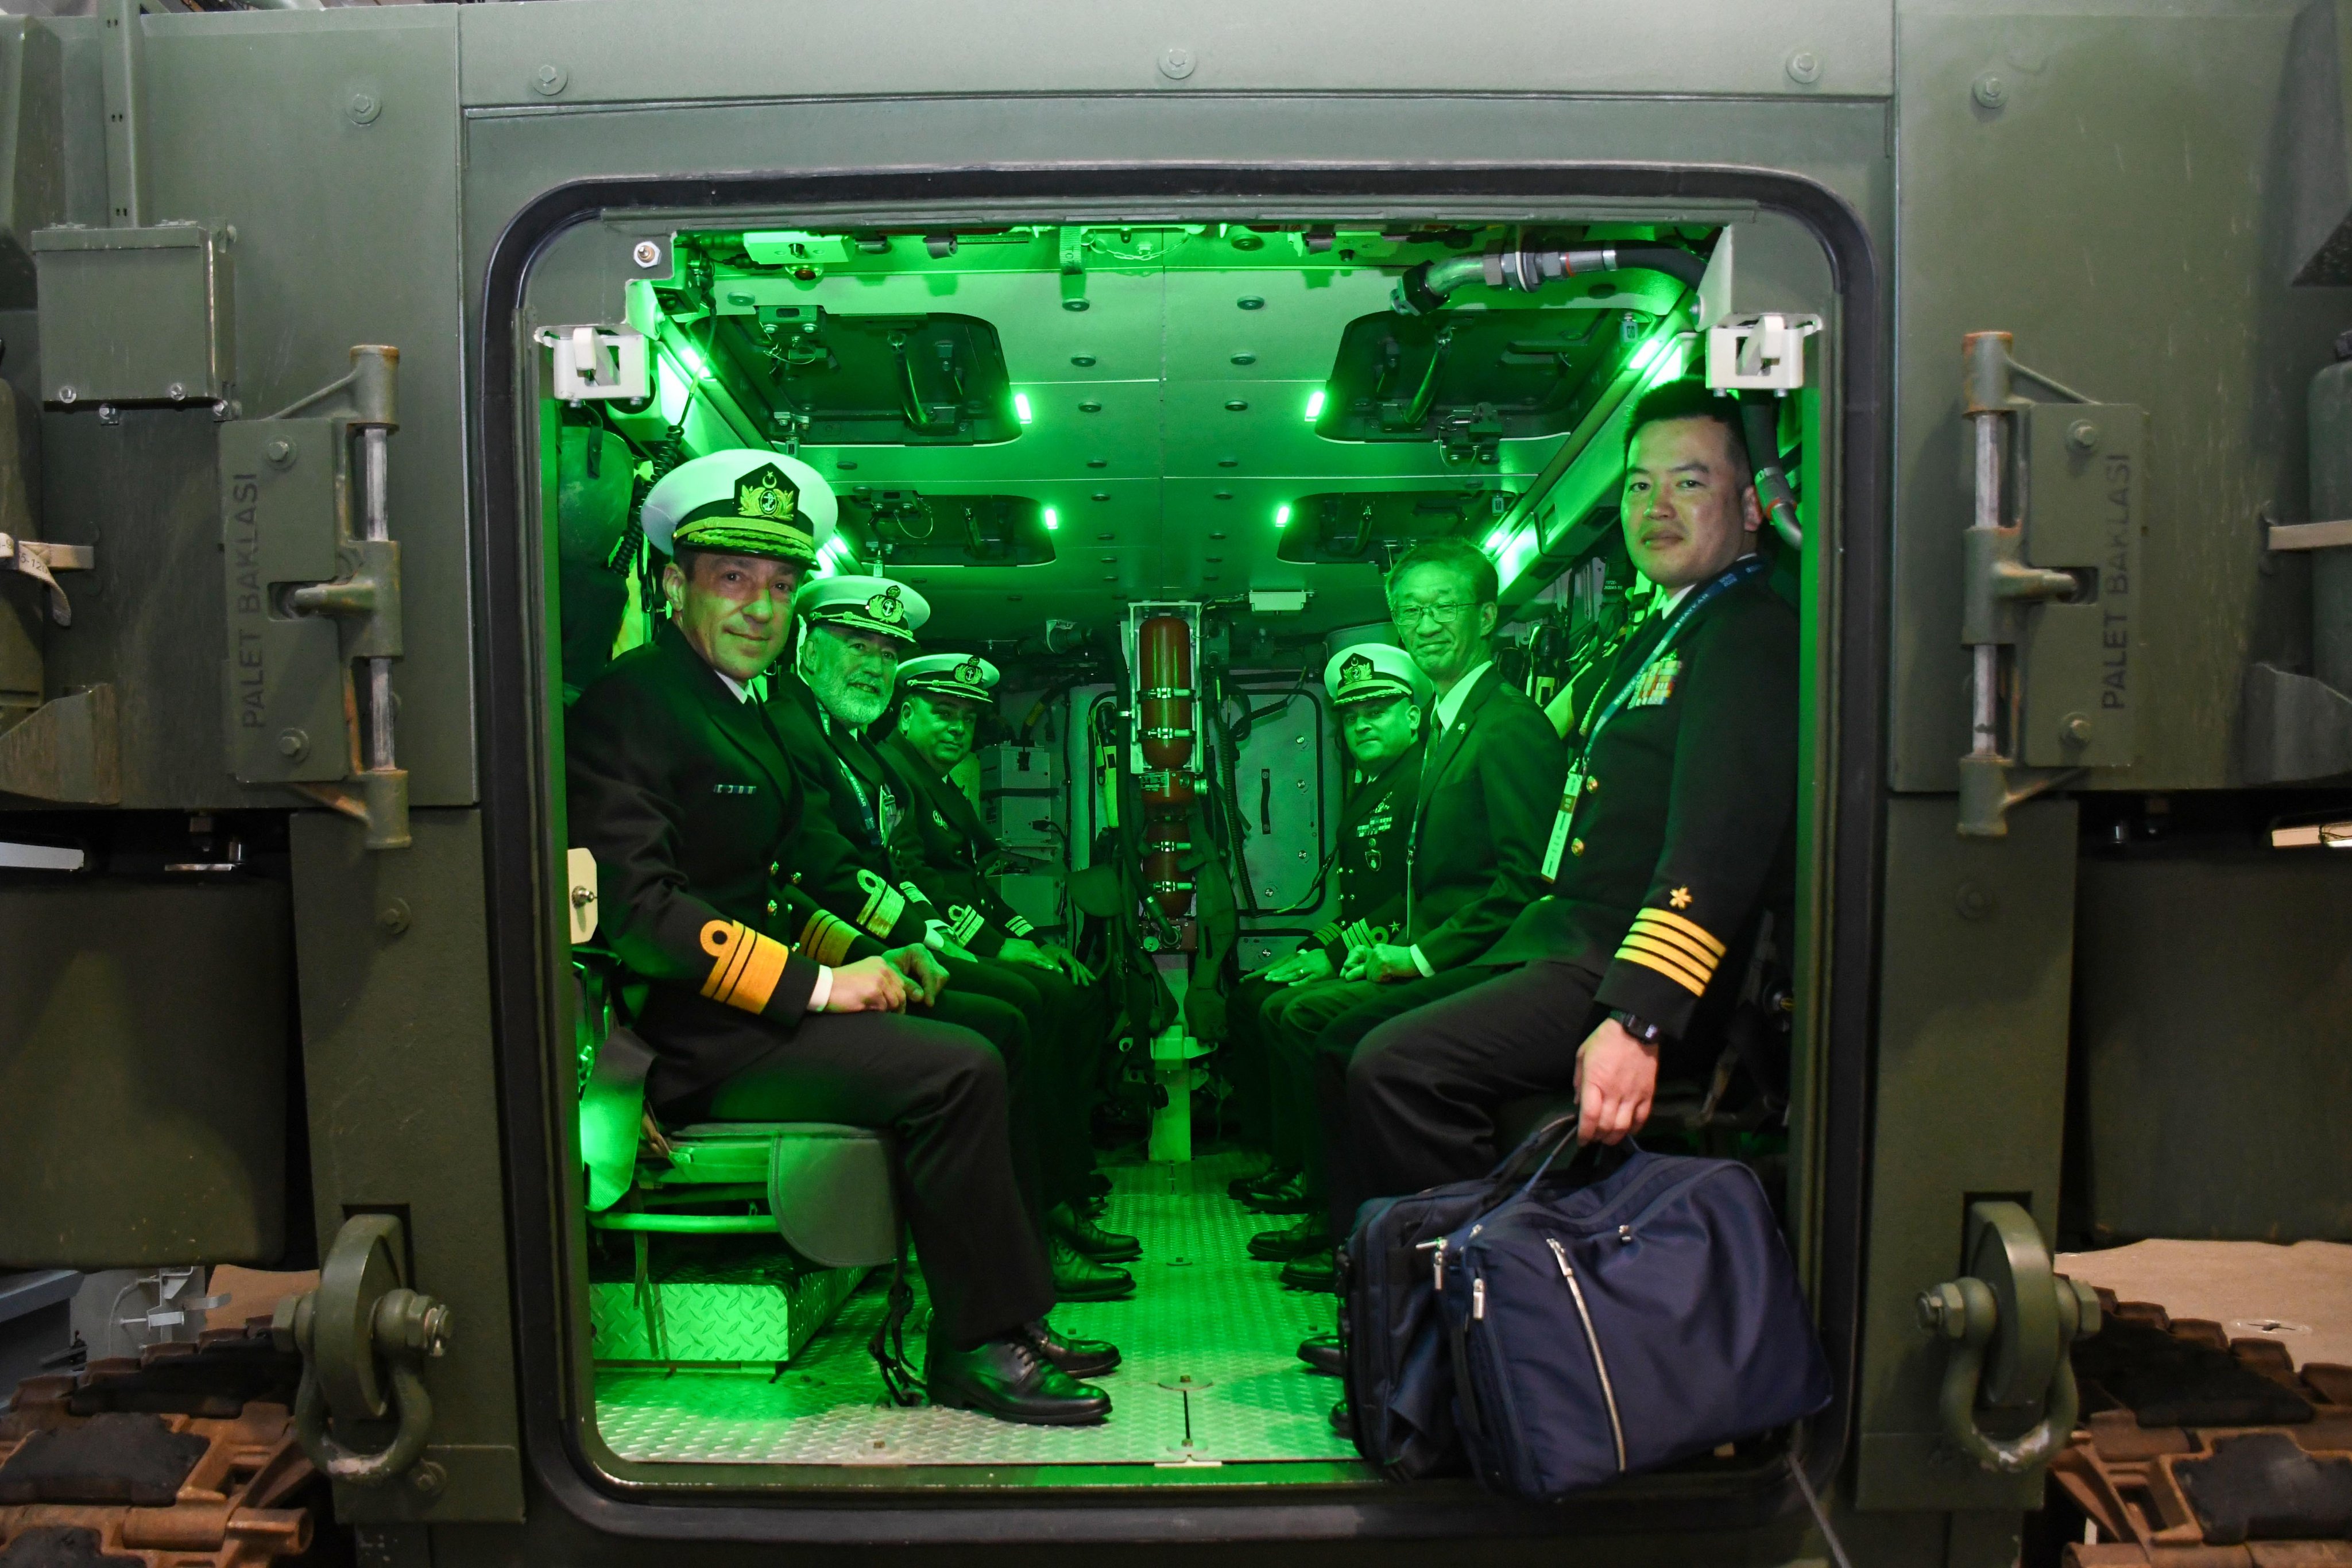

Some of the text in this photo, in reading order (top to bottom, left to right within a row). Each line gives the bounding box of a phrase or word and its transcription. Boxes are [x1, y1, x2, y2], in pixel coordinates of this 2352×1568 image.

[234, 474, 266, 728] PALET BAKLASI
[2102, 455, 2131, 708] PALET BAKLASI
[852, 781, 866, 807] BAYKAR
